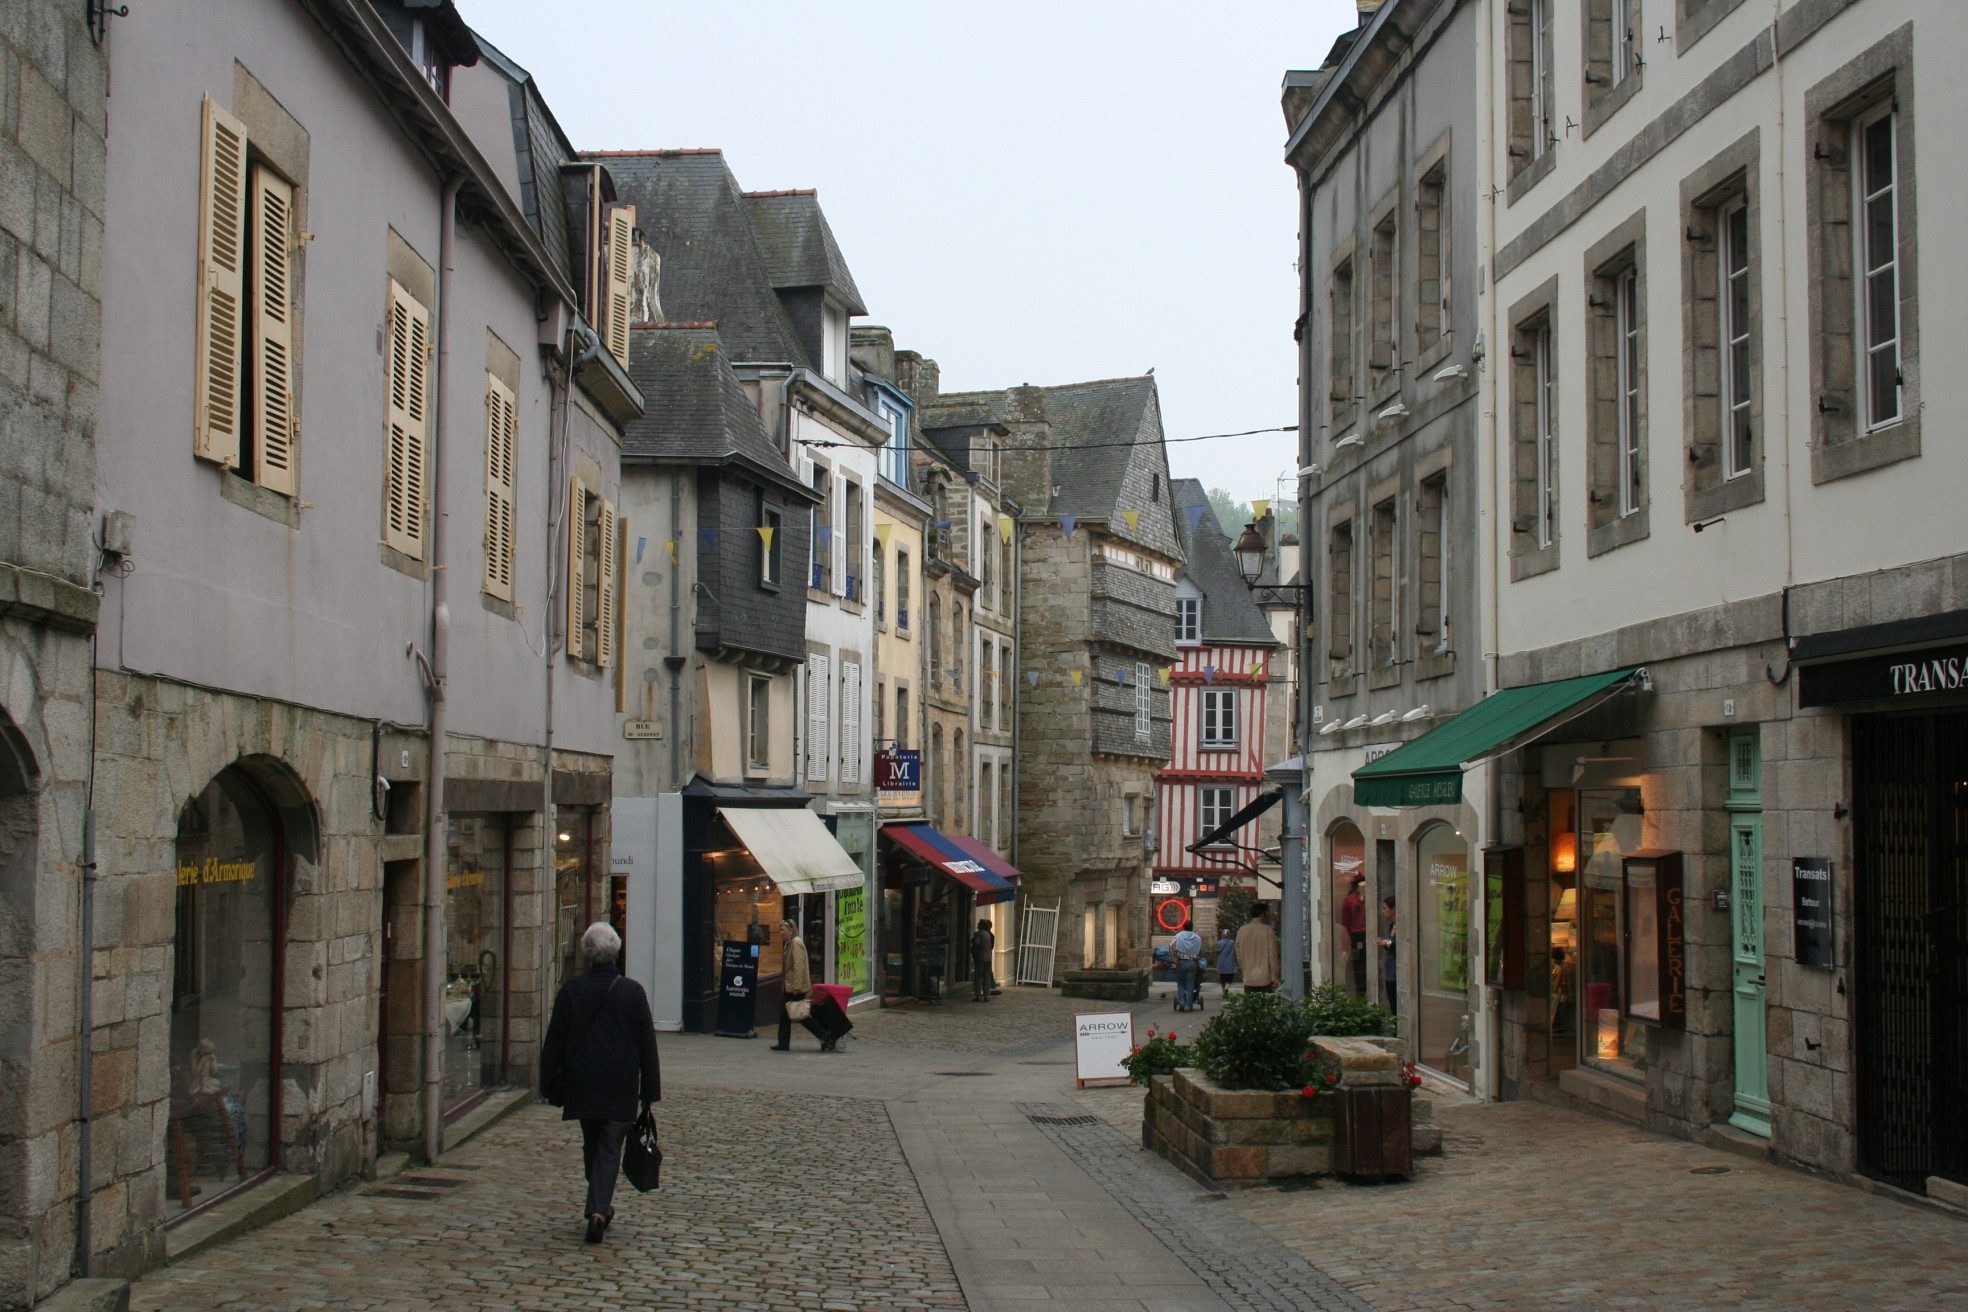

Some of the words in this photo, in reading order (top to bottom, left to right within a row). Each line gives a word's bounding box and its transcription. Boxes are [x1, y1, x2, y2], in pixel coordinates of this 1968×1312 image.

[890, 761, 910, 779] M
[203, 857, 256, 886] d'Armorique
[1430, 863, 1457, 878] ARROW
[1795, 866, 1827, 880] Transats
[1153, 883, 1170, 892] AG
[1667, 887, 1683, 1013] GALERIE
[1080, 1022, 1128, 1031] ARROW
